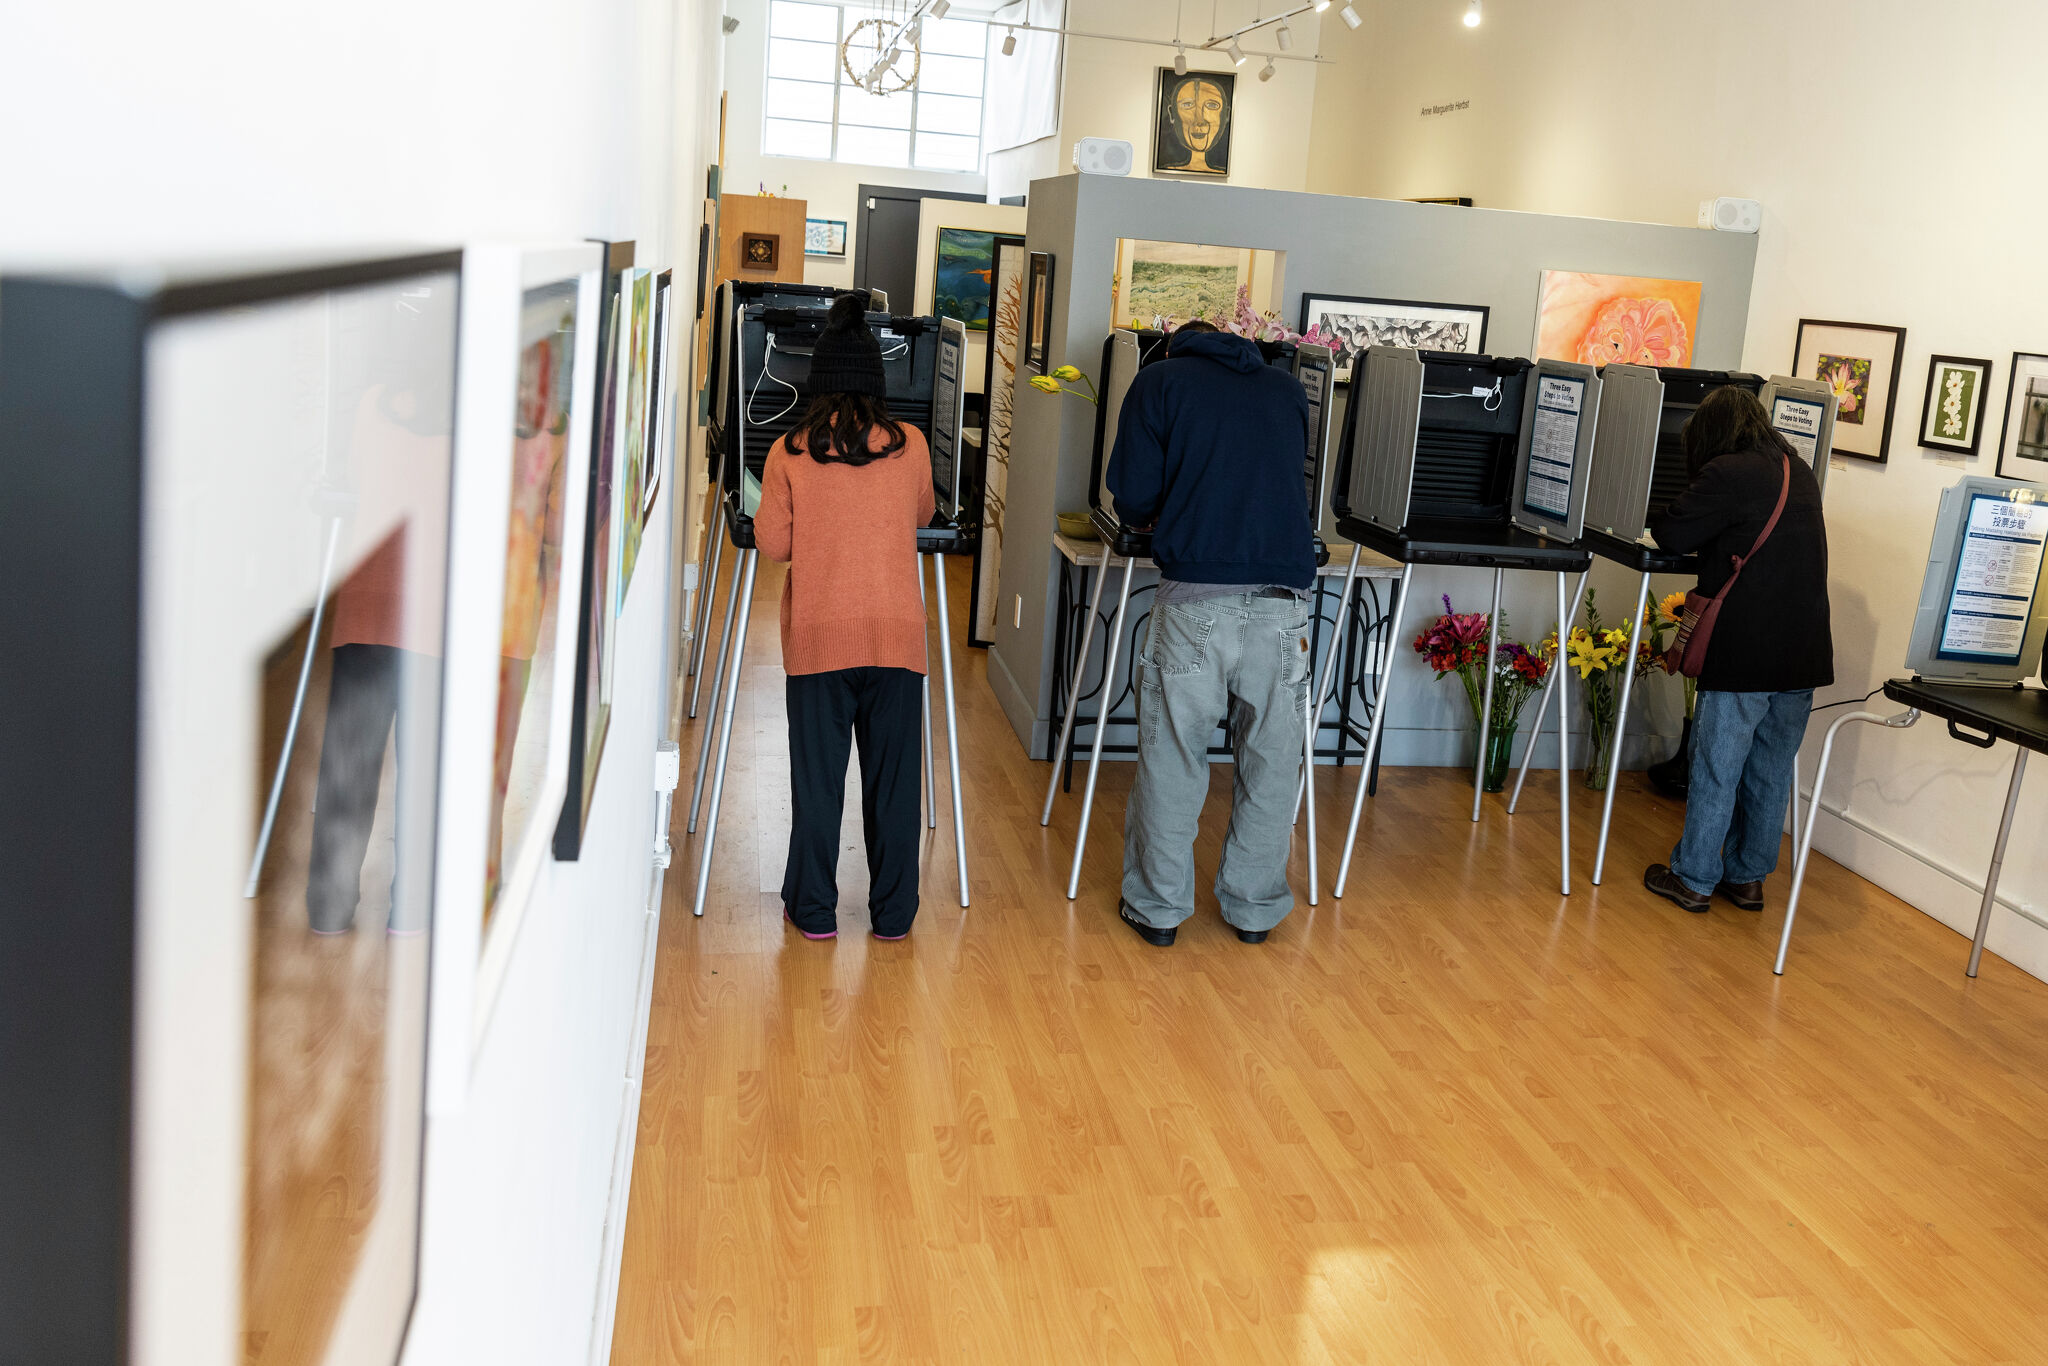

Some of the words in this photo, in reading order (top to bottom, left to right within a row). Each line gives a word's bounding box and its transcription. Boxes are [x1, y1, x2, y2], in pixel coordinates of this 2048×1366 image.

[1421, 107, 1432, 116] Anne
[1433, 102, 1454, 116] Marguerite
[1455, 100, 1469, 110] Herbst
[1550, 382, 1561, 390] Three
[1561, 384, 1571, 393] Easy
[1544, 391, 1556, 400] Steps
[1561, 394, 1574, 403] Voting
[1786, 405, 1798, 413] Three
[1799, 407, 1809, 416] Easy
[1780, 412, 1792, 422] Steps
[1798, 417, 1812, 426] Voting
